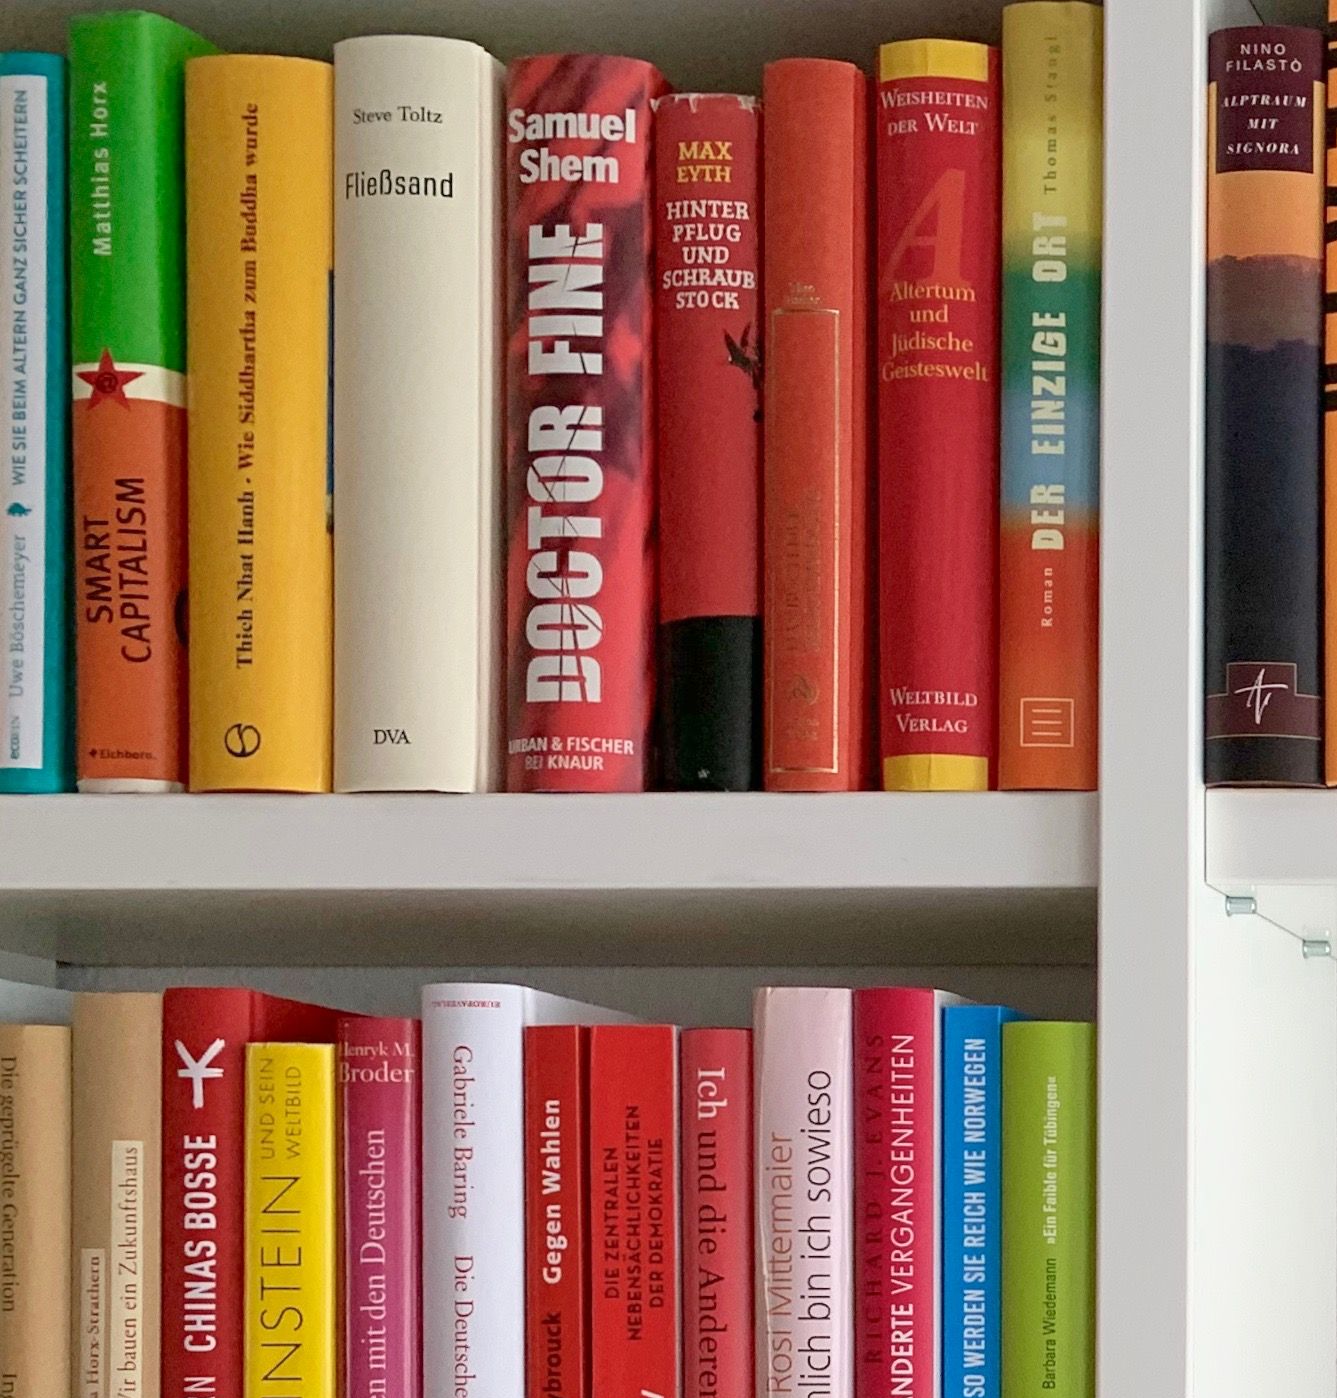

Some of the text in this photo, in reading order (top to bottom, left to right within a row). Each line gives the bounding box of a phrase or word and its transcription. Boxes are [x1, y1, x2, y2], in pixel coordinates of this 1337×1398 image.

[1226, 58, 1302, 73] FILASTÒ
[1240, 43, 1286, 56] NINO
[353, 106, 443, 125] Steve Toltz
[508, 109, 636, 142] Samuel
[91, 82, 112, 255] Matthias Horx
[520, 149, 619, 183] Shem
[678, 142, 732, 161] MAX
[345, 169, 454, 200] Fließsand
[677, 165, 731, 184] EYTH
[666, 201, 750, 221] HINTER
[673, 223, 741, 243] PFLUG
[682, 246, 729, 264] UND
[663, 269, 754, 288] SCHRAUB
[675, 291, 739, 310] STOCK
[1032, 211, 1066, 551] DER EINZIGE ORT
[526, 223, 603, 703] DOCTOR FINE
[86, 516, 113, 625] SMART
[122, 476, 151, 664] CAPITALISM
[373, 729, 410, 745] DVA
[695, 1067, 726, 1120] Ich
[695, 1129, 725, 1189] und
[890, 1033, 914, 1294] VERGANGENHEITEN
[184, 1135, 216, 1229] BOSSE
[359, 1130, 385, 1264] Deutschen
[540, 1100, 567, 1283] Gegen Wahlen
[696, 1199, 725, 1255] die
[184, 1241, 216, 1351] CHINAS
[360, 1275, 386, 1320] den
[361, 1326, 386, 1369] mit
